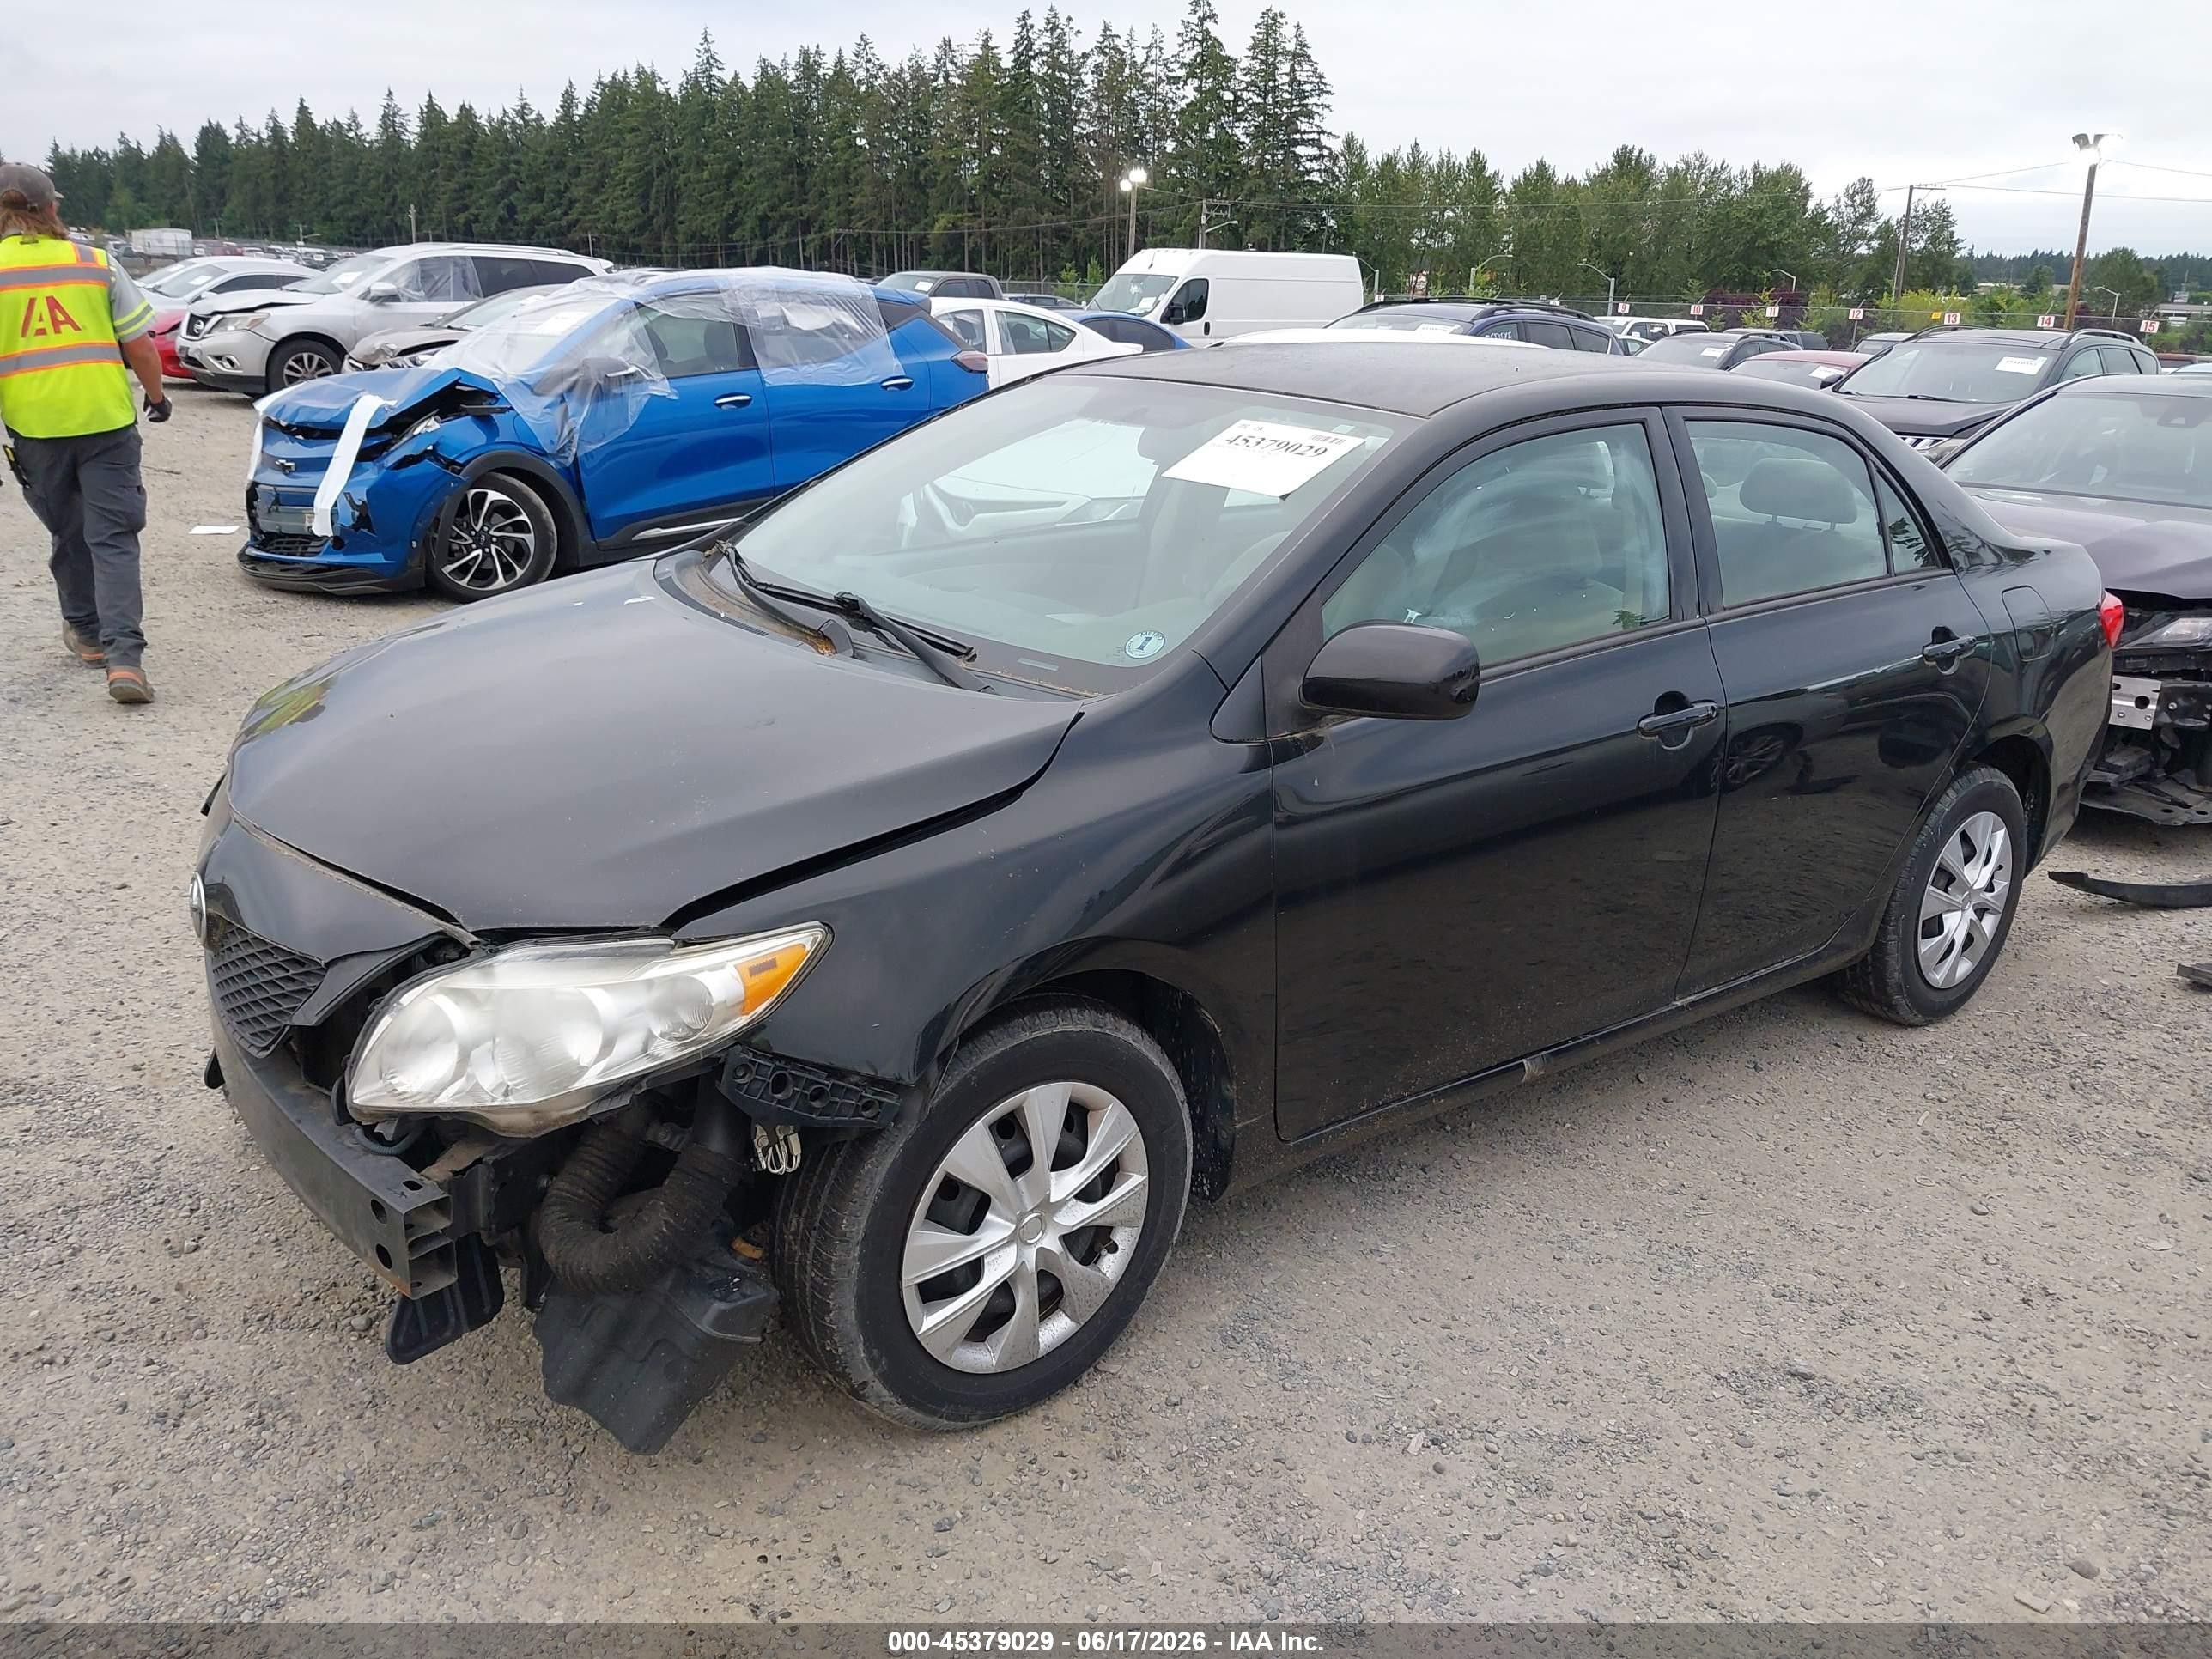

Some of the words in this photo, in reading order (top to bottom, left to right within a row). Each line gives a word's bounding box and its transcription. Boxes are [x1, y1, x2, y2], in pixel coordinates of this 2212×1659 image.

[1621, 302, 1626, 313] 9
[1692, 305, 1701, 314] 10
[1769, 307, 1777, 315] 11
[1851, 309, 1861, 319] 12
[1948, 314, 1958, 324] 13
[2040, 316, 2051, 326] 14
[2142, 321, 2156, 331] 15
[1225, 434, 1328, 458] 45379029
